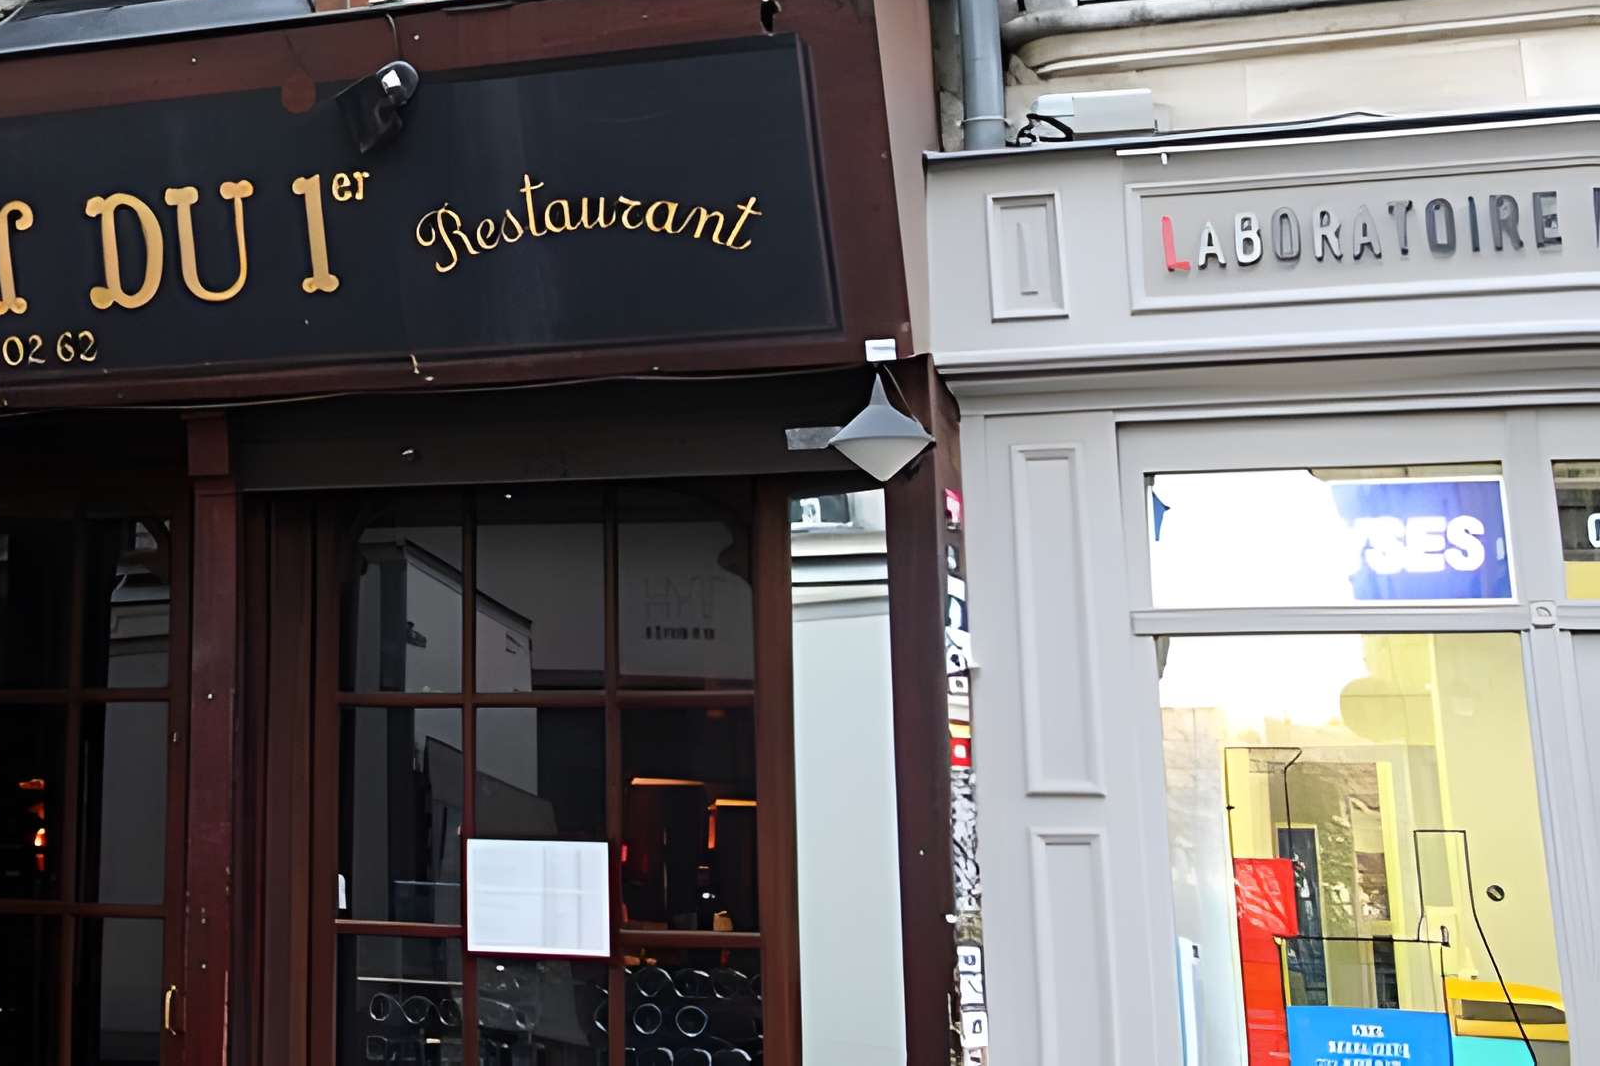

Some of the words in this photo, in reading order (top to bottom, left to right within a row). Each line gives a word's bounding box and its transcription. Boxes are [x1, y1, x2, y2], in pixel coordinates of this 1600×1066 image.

[85, 180, 254, 311] DU
[416, 173, 763, 274] Restaurant
[1160, 190, 1564, 272] LABORATOIRE
